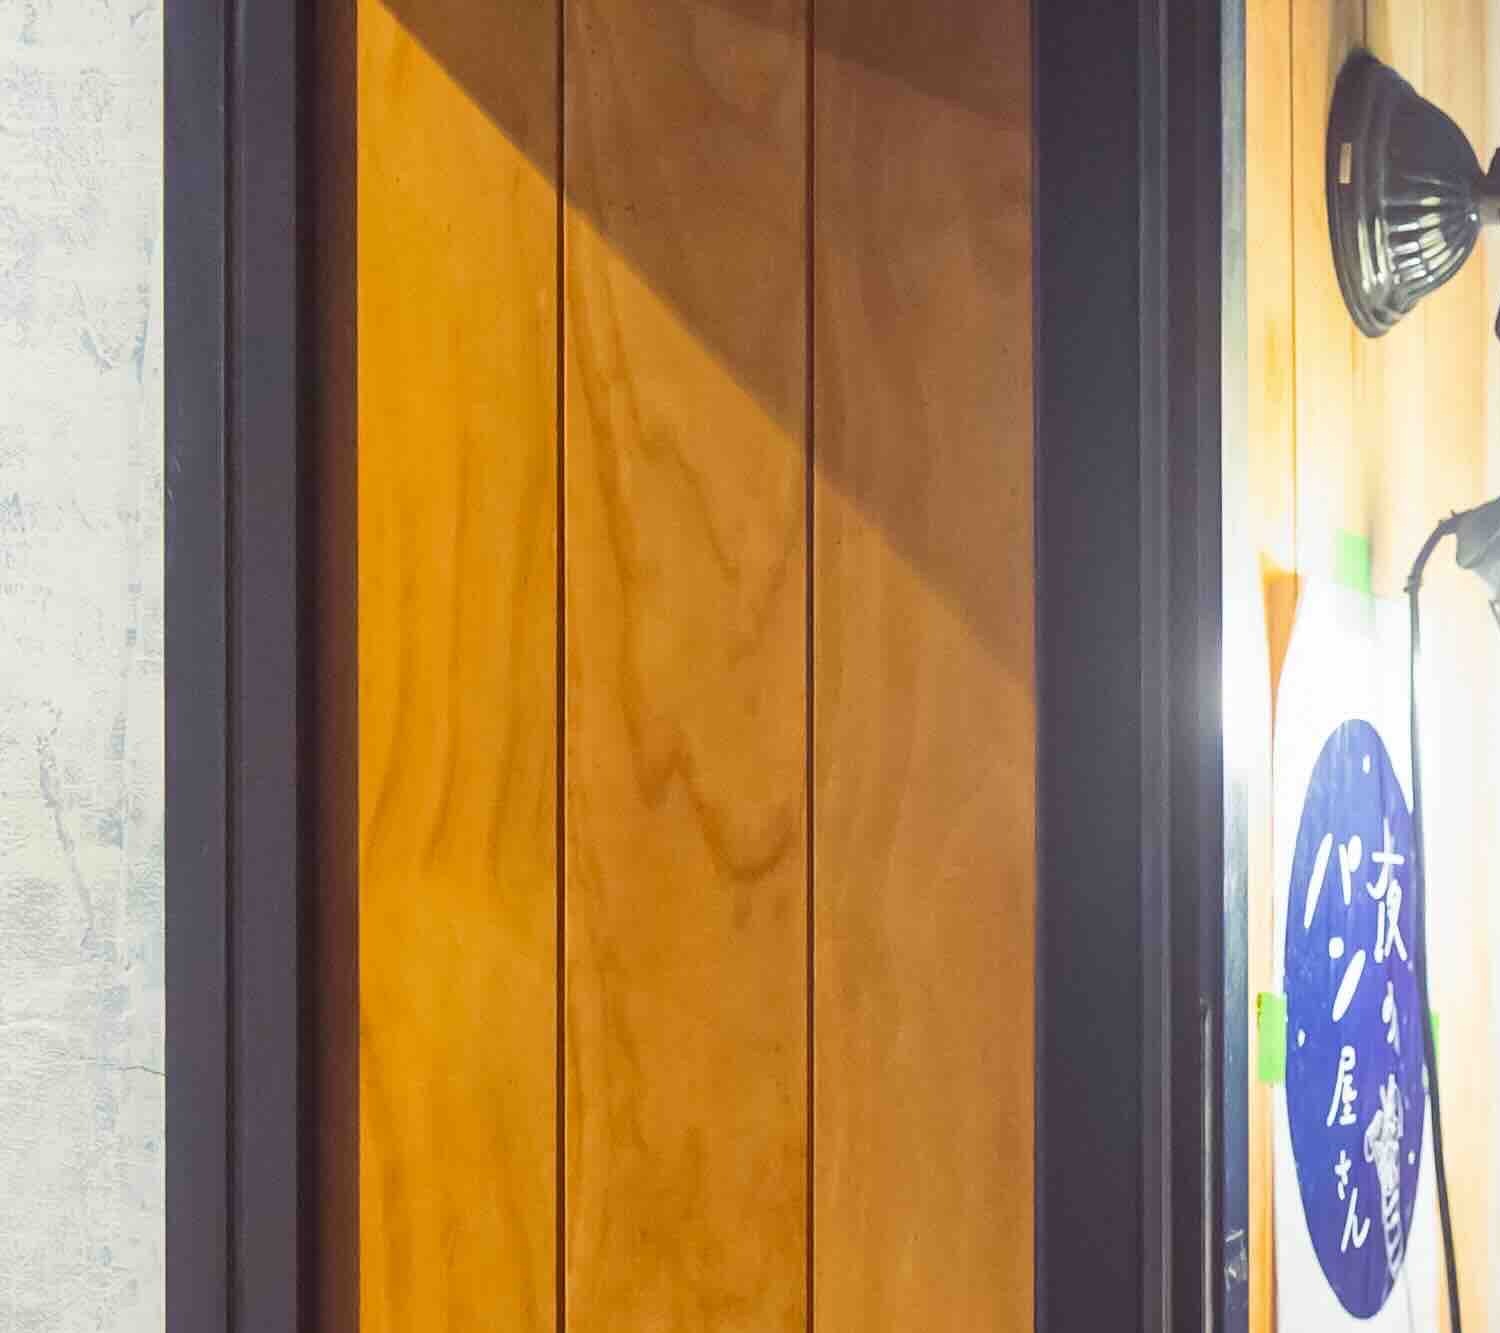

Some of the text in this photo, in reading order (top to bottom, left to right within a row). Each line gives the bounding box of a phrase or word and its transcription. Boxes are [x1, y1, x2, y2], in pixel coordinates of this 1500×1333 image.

[1303, 832, 1369, 1253] パン屋さん
